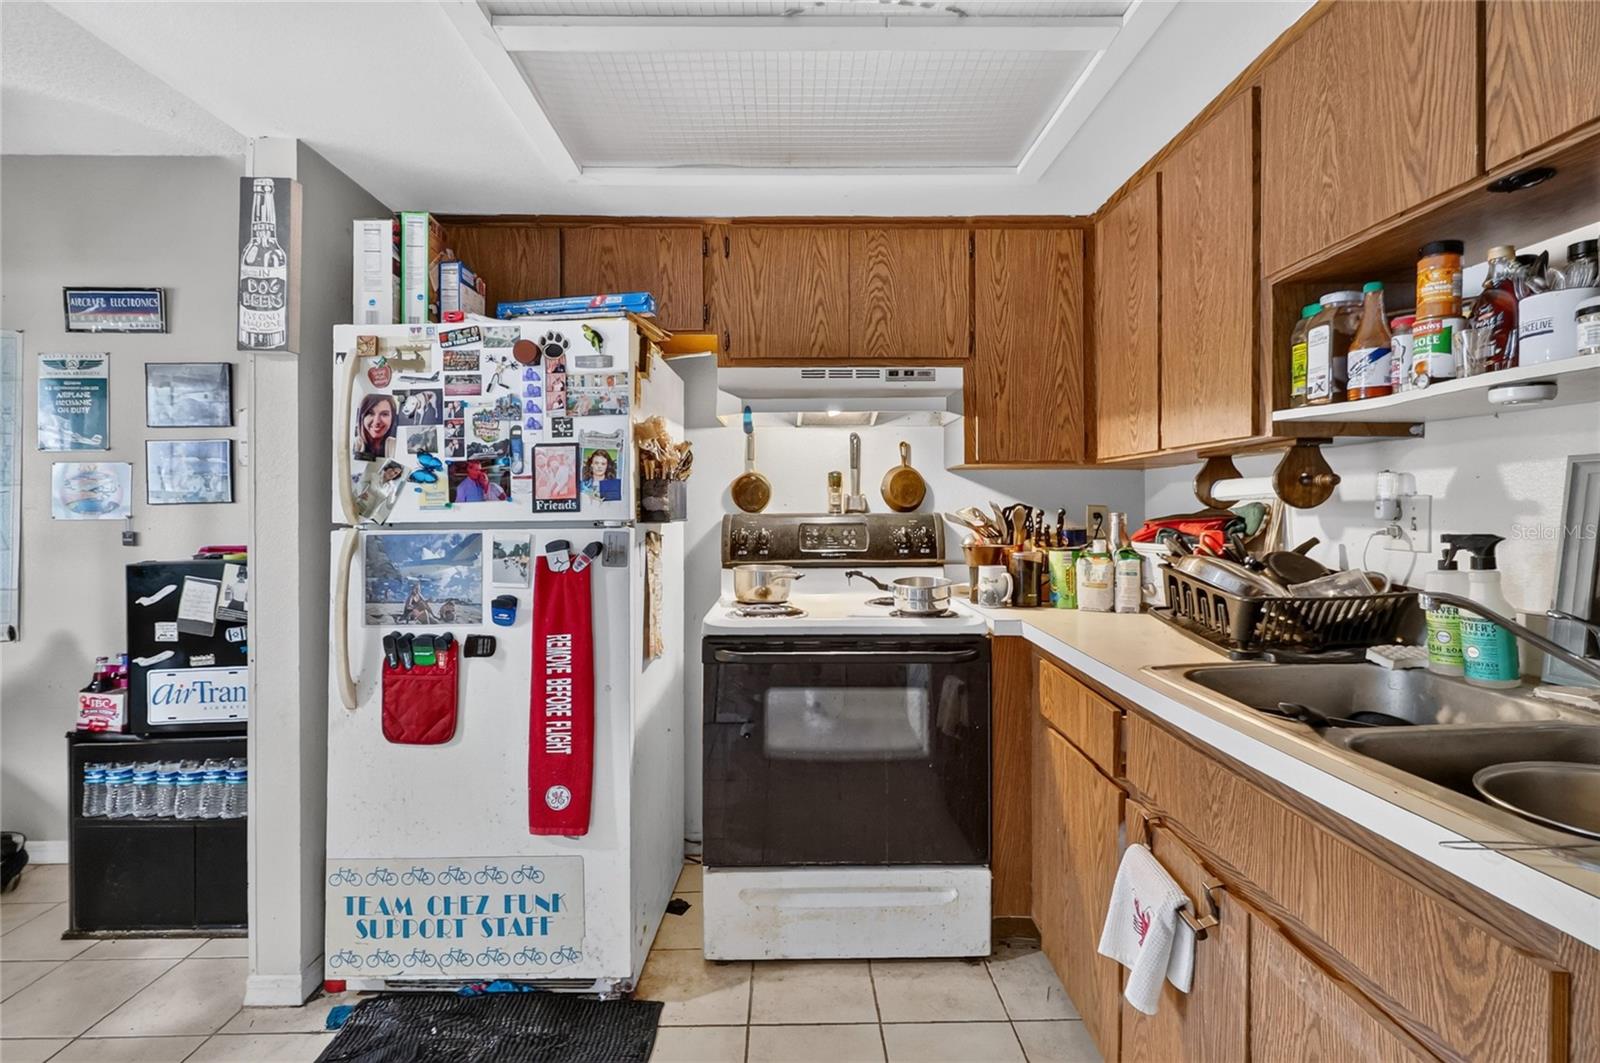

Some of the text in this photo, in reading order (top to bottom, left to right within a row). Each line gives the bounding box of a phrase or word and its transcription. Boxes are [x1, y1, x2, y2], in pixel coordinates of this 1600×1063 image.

[247, 279, 281, 294] DOG
[242, 291, 283, 308] BEERS
[536, 500, 577, 511] Friends
[152, 680, 247, 706] airTran
[546, 634, 572, 755] REMOVE BEFORE FLIGHT
[344, 892, 568, 916] TEAM CHEZ FUNK
[355, 916, 555, 939] SUPPORT STAFF
